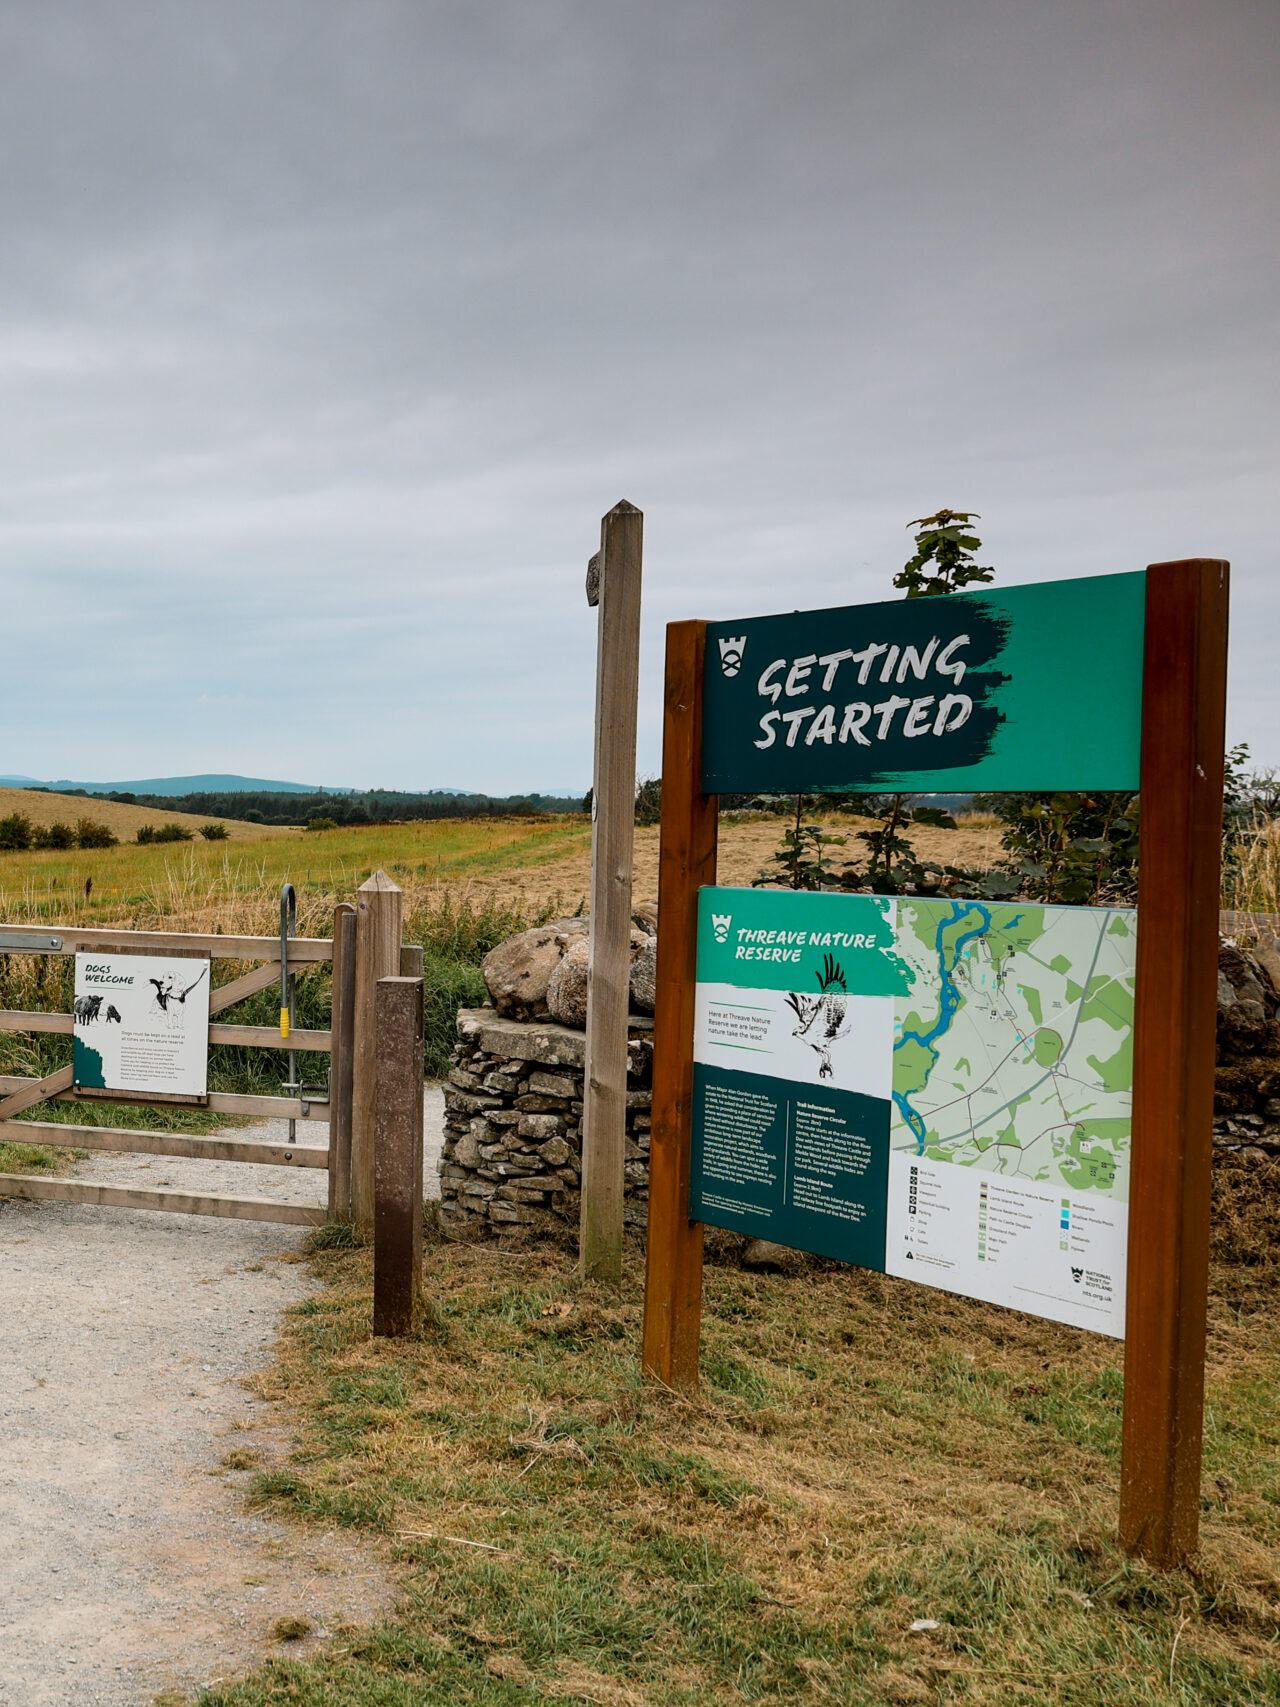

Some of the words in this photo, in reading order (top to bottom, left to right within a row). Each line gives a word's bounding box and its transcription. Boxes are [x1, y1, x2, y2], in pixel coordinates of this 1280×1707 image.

[758, 634, 970, 705] GETTING
[753, 694, 973, 749] STARTED
[737, 928, 807, 945] THREAVE
[809, 932, 877, 948] NATURE
[735, 946, 802, 963] RESERVE
[85, 964, 111, 974] DOGS
[85, 975, 134, 984] WELCOME
[708, 1010, 721, 1018] Here
[729, 1012, 750, 1022] Threave
[752, 1016, 771, 1024] Nature
[708, 1018, 729, 1028] Reserve
[749, 1023, 768, 1034] letting
[750, 1033, 762, 1041] lead.
[807, 1103, 835, 1114] Information
[830, 1116, 847, 1124] Circular
[841, 1132, 866, 1142] information
[1086, 1270, 1112, 1280] NATIONAL
[1086, 1276, 1102, 1284] TRUST
[1086, 1281, 1112, 1292] SCOTLAND
[1082, 1290, 1112, 1302] nts.org.uk
